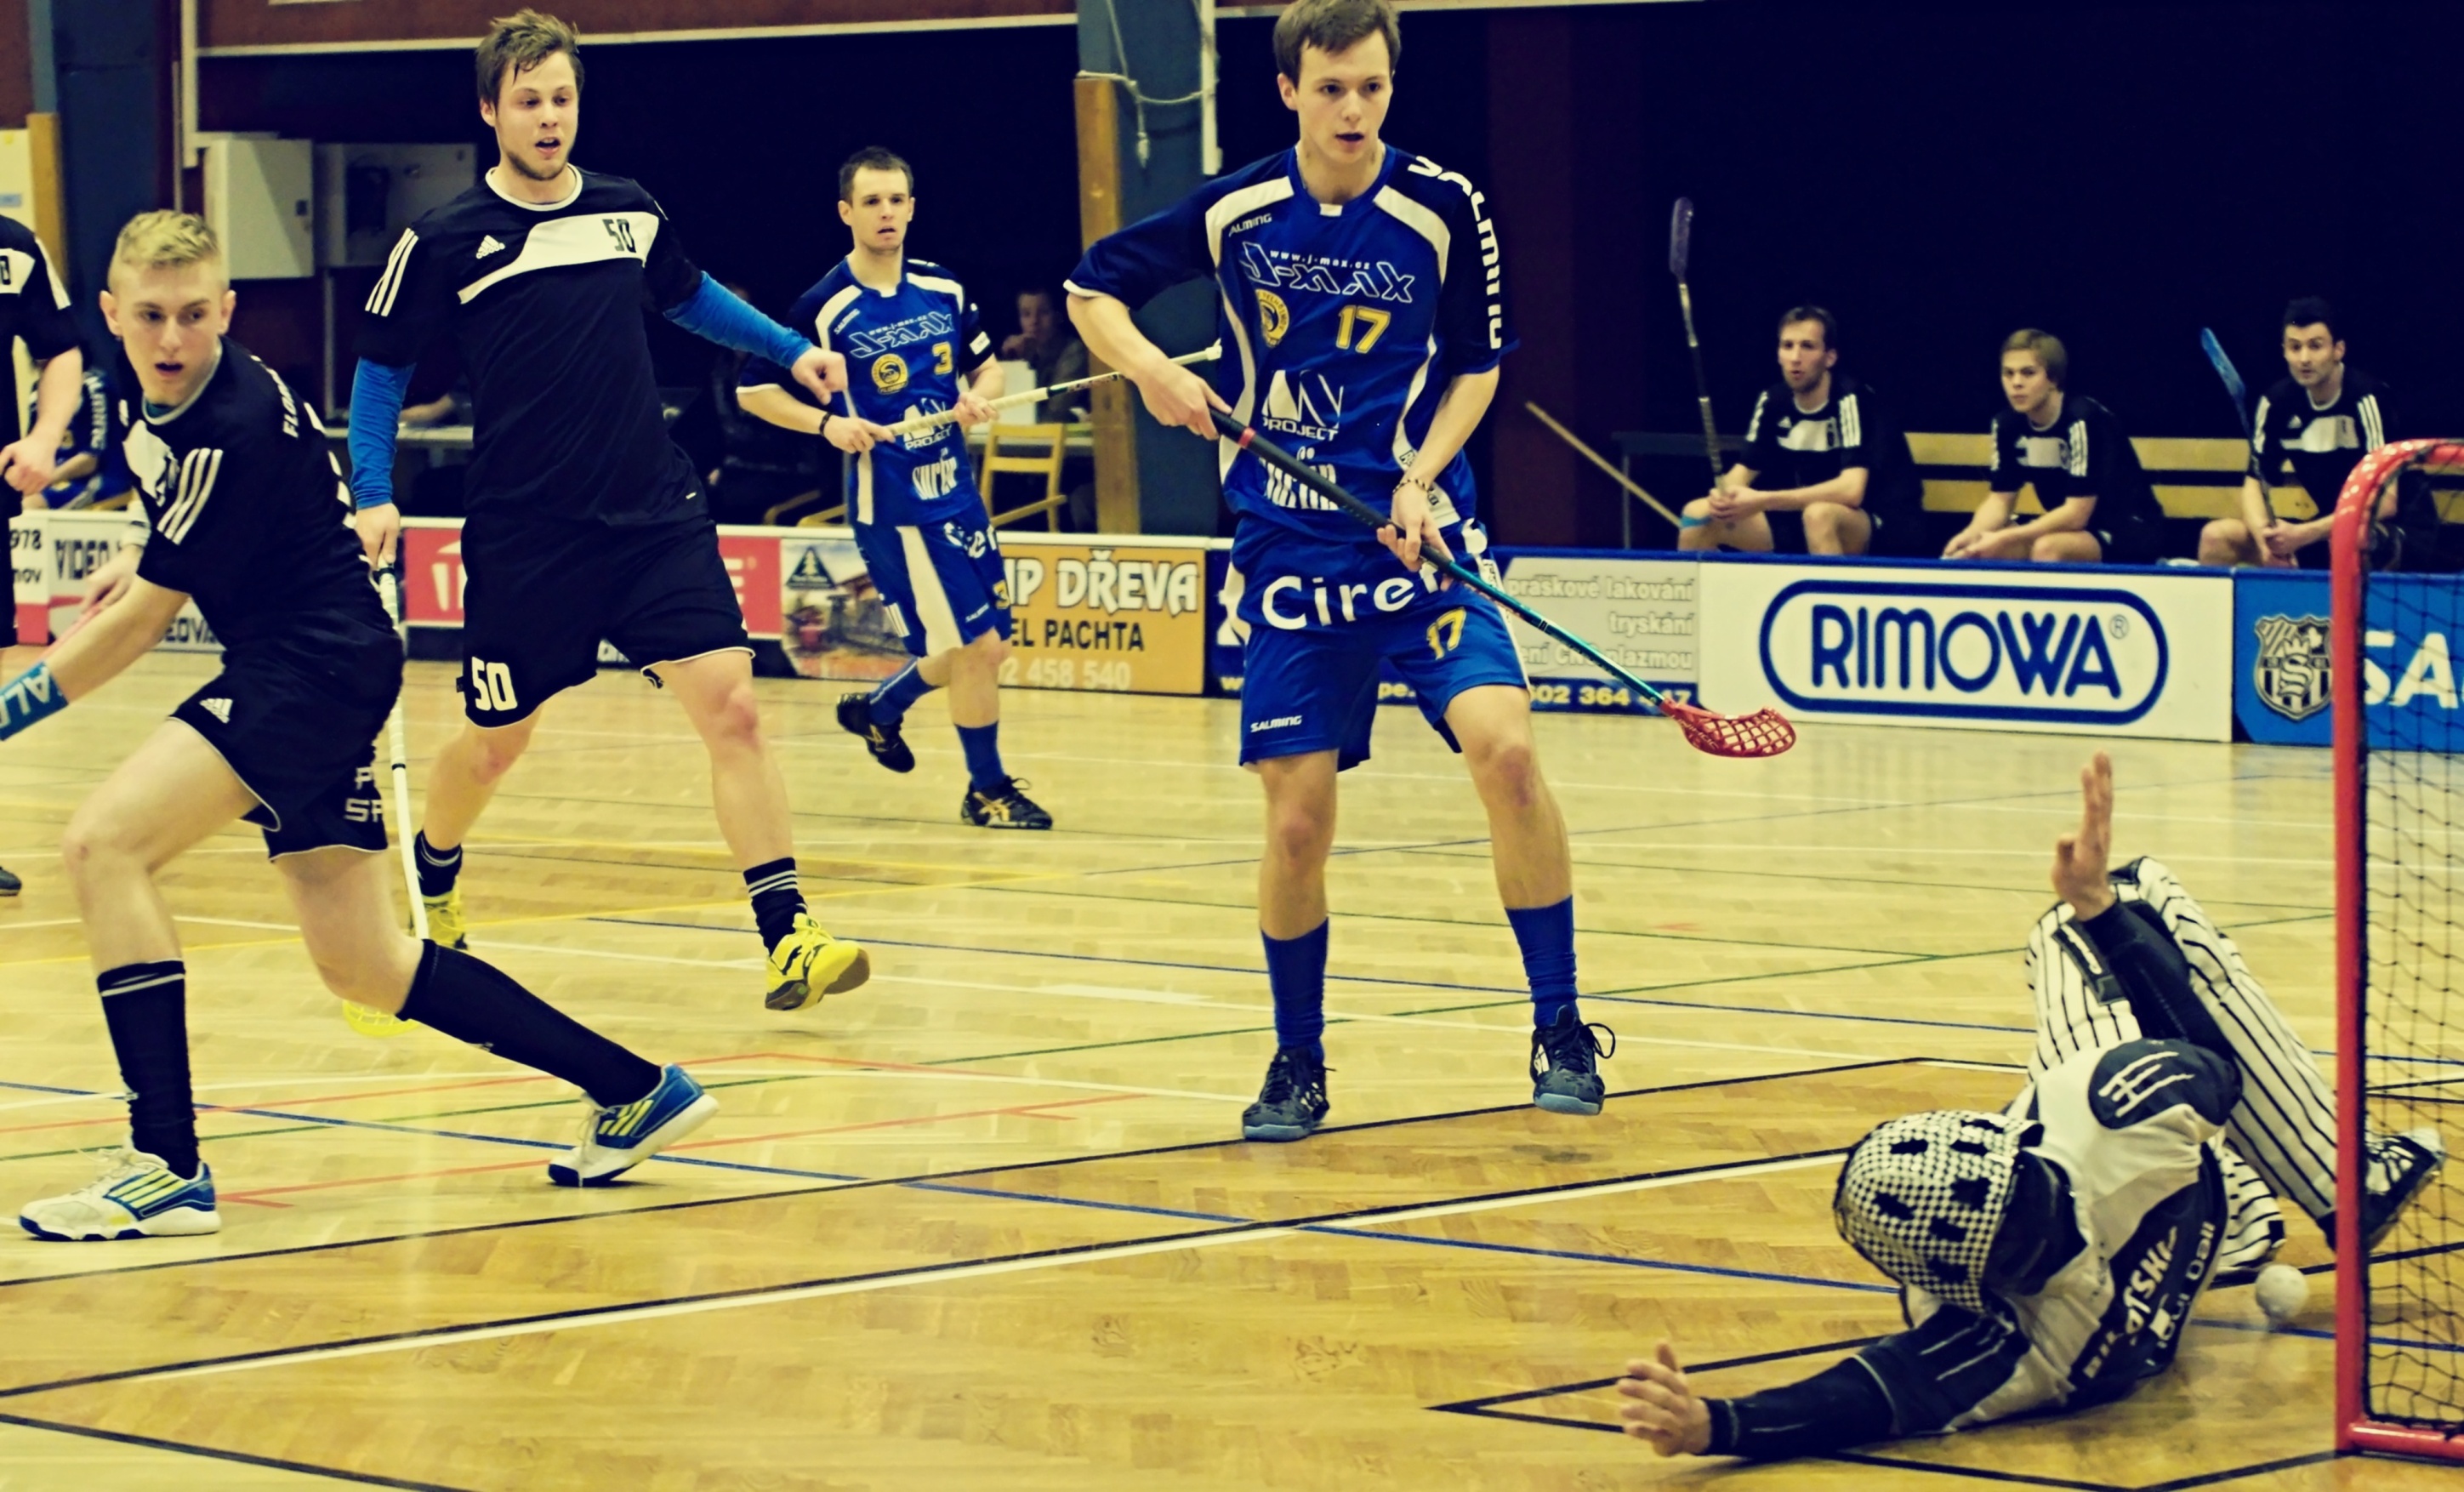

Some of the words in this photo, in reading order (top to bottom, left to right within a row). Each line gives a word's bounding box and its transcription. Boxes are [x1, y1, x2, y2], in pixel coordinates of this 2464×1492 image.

[601, 218, 637, 253] 50
[1335, 304, 1391, 355] 17
[931, 340, 953, 376] 3
[1056, 547, 1199, 618] DŘEVA
[1606, 577, 1696, 601] lakování
[1044, 619, 1146, 652] PACHTA
[1610, 612, 1696, 638] tryskání
[1812, 603, 2122, 699] RIMOWA
[470, 655, 519, 712] 50
[1026, 657, 1075, 689] 458
[1082, 659, 1133, 692] 540
[1579, 686, 1632, 707] 364
[1249, 715, 1303, 733] SALMING
